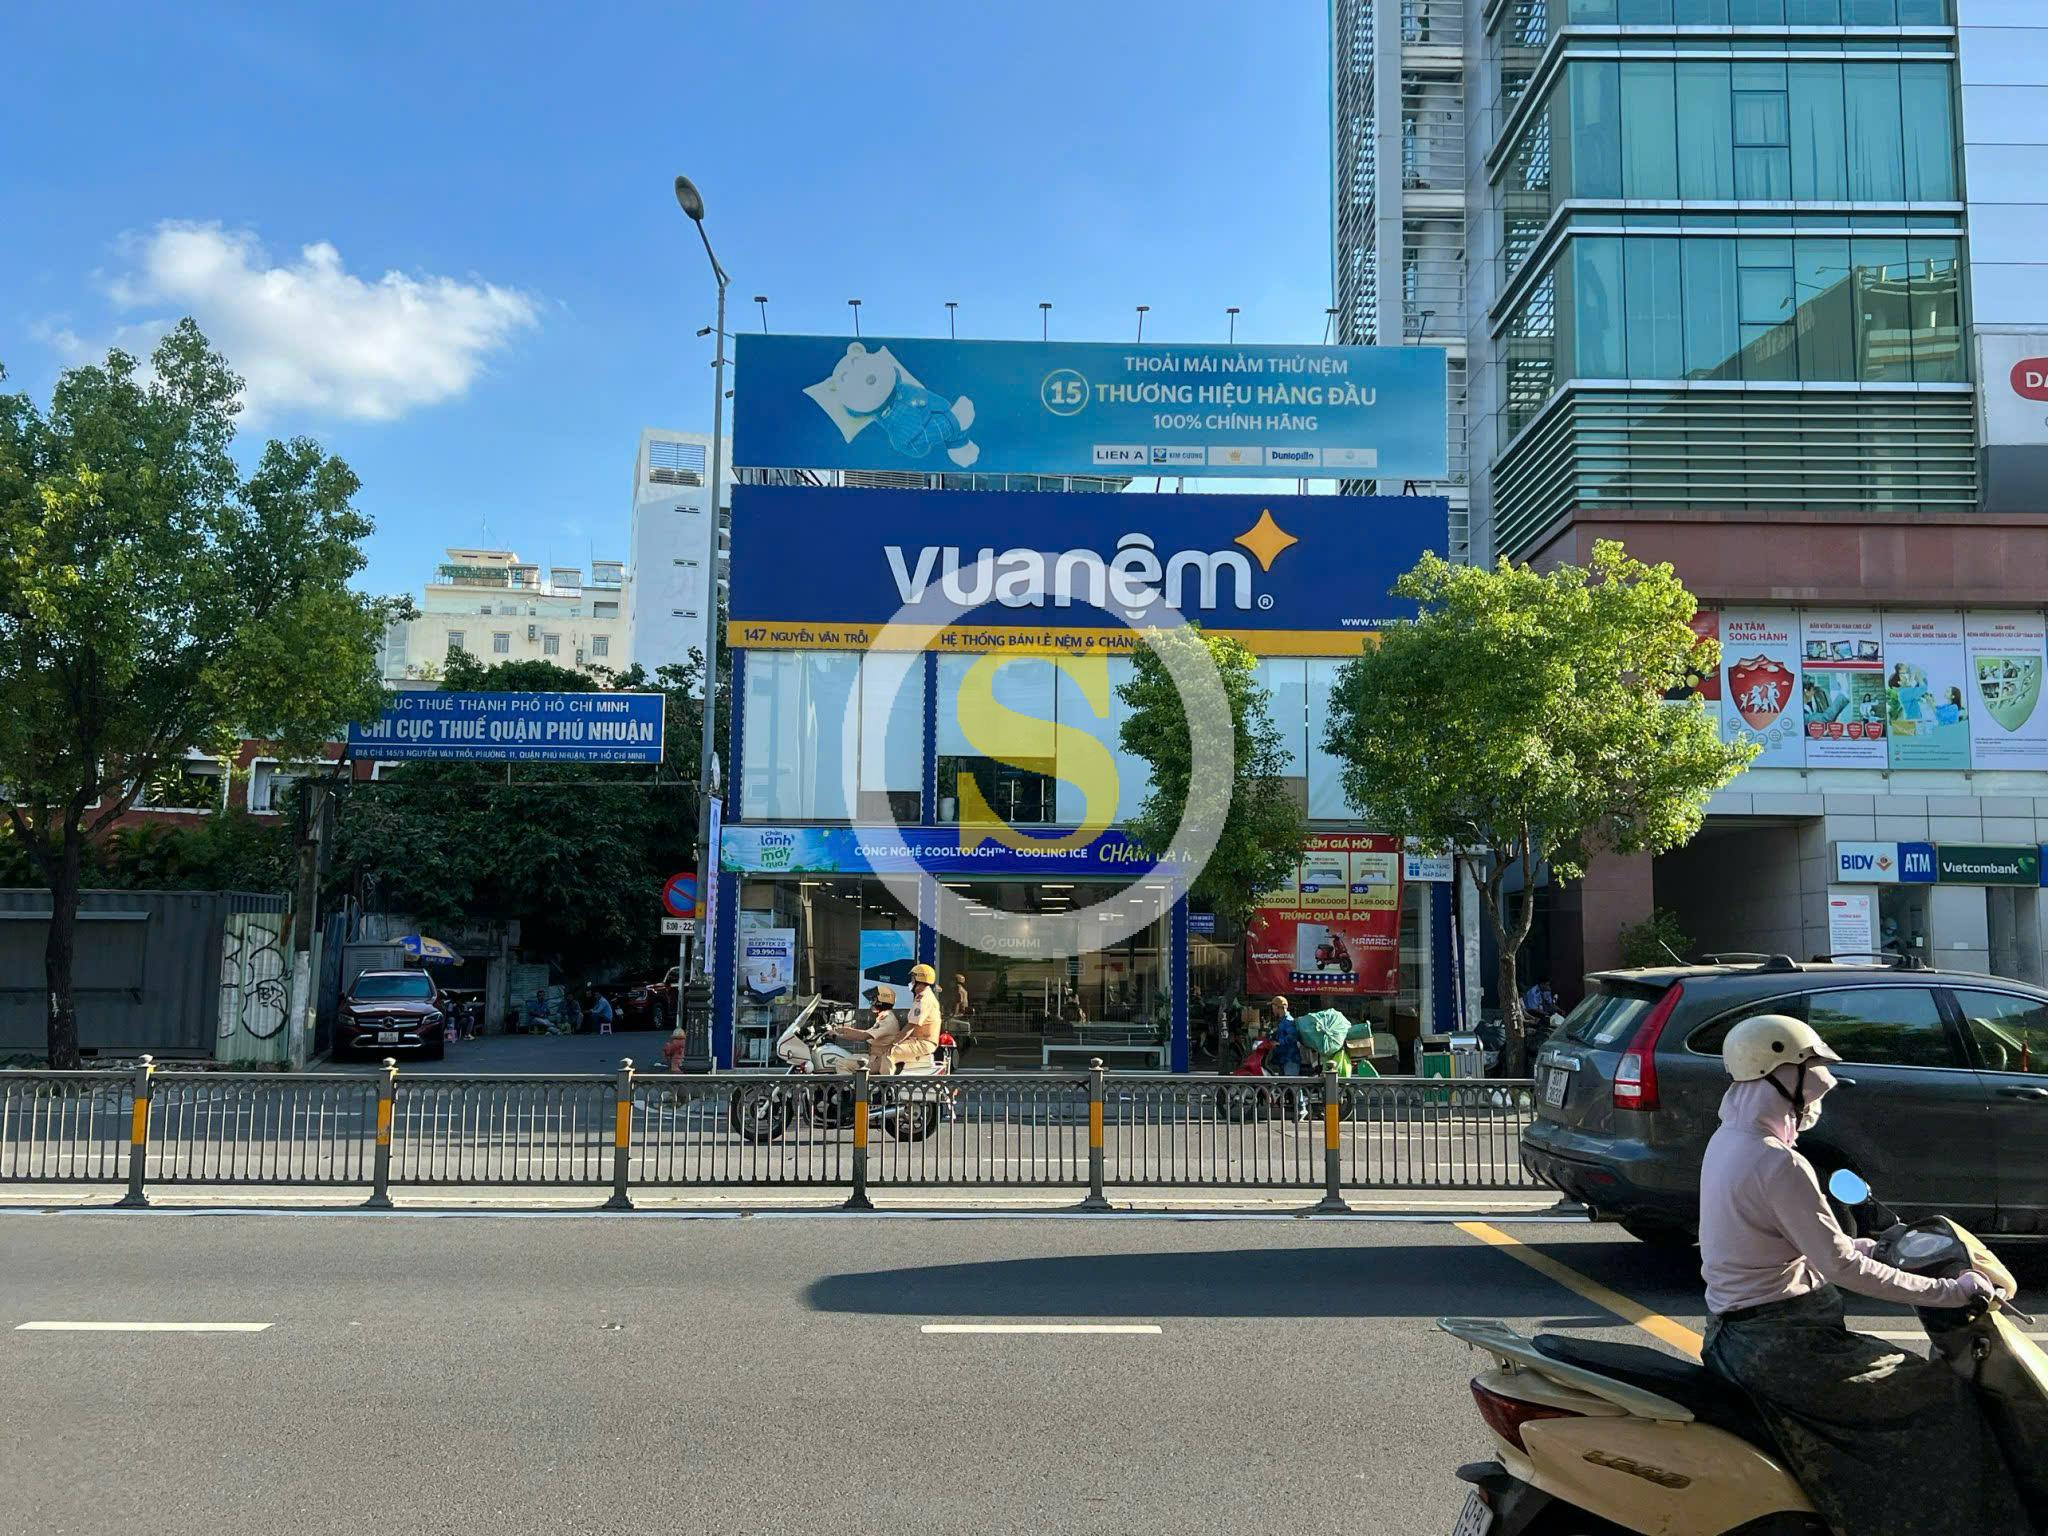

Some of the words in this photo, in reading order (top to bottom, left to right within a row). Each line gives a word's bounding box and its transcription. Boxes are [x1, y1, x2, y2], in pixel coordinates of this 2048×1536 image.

[1124, 352, 1180, 373] THOẢI
[1183, 354, 1217, 373] MÁI
[1221, 353, 1263, 373] NẰM
[1267, 353, 1305, 373] THỬ
[1308, 355, 1348, 376] NỆM
[2025, 371, 2048, 388] D
[1050, 381, 1082, 405] 15
[1095, 382, 1193, 404] THƯƠNG
[1198, 382, 1251, 407] HIỆU
[1257, 382, 1322, 405] HÀNG
[1327, 381, 1377, 406] ĐẦU
[1153, 414, 1202, 429] 100%
[1205, 411, 1262, 430] CHÍNH
[1266, 413, 1318, 431] HÃNG
[1096, 450, 1130, 460] LIEN
[1134, 450, 1144, 460] A
[1271, 451, 1314, 461] Dunlopillo
[1728, 622, 1742, 631] AN
[1744, 621, 1766, 631] TÂM
[744, 628, 767, 641] 147
[770, 628, 814, 643] NGUYỄN
[819, 631, 840, 643] VĂN
[844, 629, 868, 644] TRỖI
[941, 632, 957, 647] HỆ
[961, 630, 1005, 646] THỐNG
[1008, 633, 1034, 646] BÁN
[1037, 631, 1051, 647] LẺ
[1055, 632, 1082, 649] NỆM
[1085, 635, 1094, 647] &
[1728, 632, 1757, 641] SONG
[1758, 631, 1788, 641] HÀNH
[417, 695, 454, 711] THUẾ
[459, 697, 506, 711] THÀNH
[511, 695, 541, 711] PHỐ
[545, 696, 565, 712] HỒ
[570, 698, 592, 712] CHÍ
[596, 701, 630, 713] MINH
[396, 719, 434, 742] CỤC
[439, 714, 486, 740] THUẾ
[490, 717, 542, 743] QUẬN
[546, 718, 584, 741] PHÚ
[588, 719, 654, 744] NHUẬN
[406, 747, 438, 758] NGUYỄN
[439, 748, 454, 758] VĂN
[519, 750, 540, 760] QUẬN
[542, 750, 557, 760] PHÚ
[600, 750, 612, 760] HỒ
[613, 750, 626, 760] CHÍ
[627, 751, 646, 760] MINH
[854, 844, 887, 857] CÔNG
[889, 843, 922, 859] NGHỆ
[1015, 847, 1067, 858] COOLING
[1069, 848, 1088, 859] ICE
[1330, 837, 1351, 849] GIÁ
[1352, 837, 1373, 850] HỜI
[1841, 855, 1874, 870] BIDV
[1904, 854, 1931, 873] ATM
[1942, 861, 2019, 875] Vietcombank
[1279, 910, 1312, 921] TRÚNG
[1313, 910, 1335, 921] QUÀ
[1352, 910, 1371, 921] ĐỜI
[998, 937, 1041, 949] GUMMI
